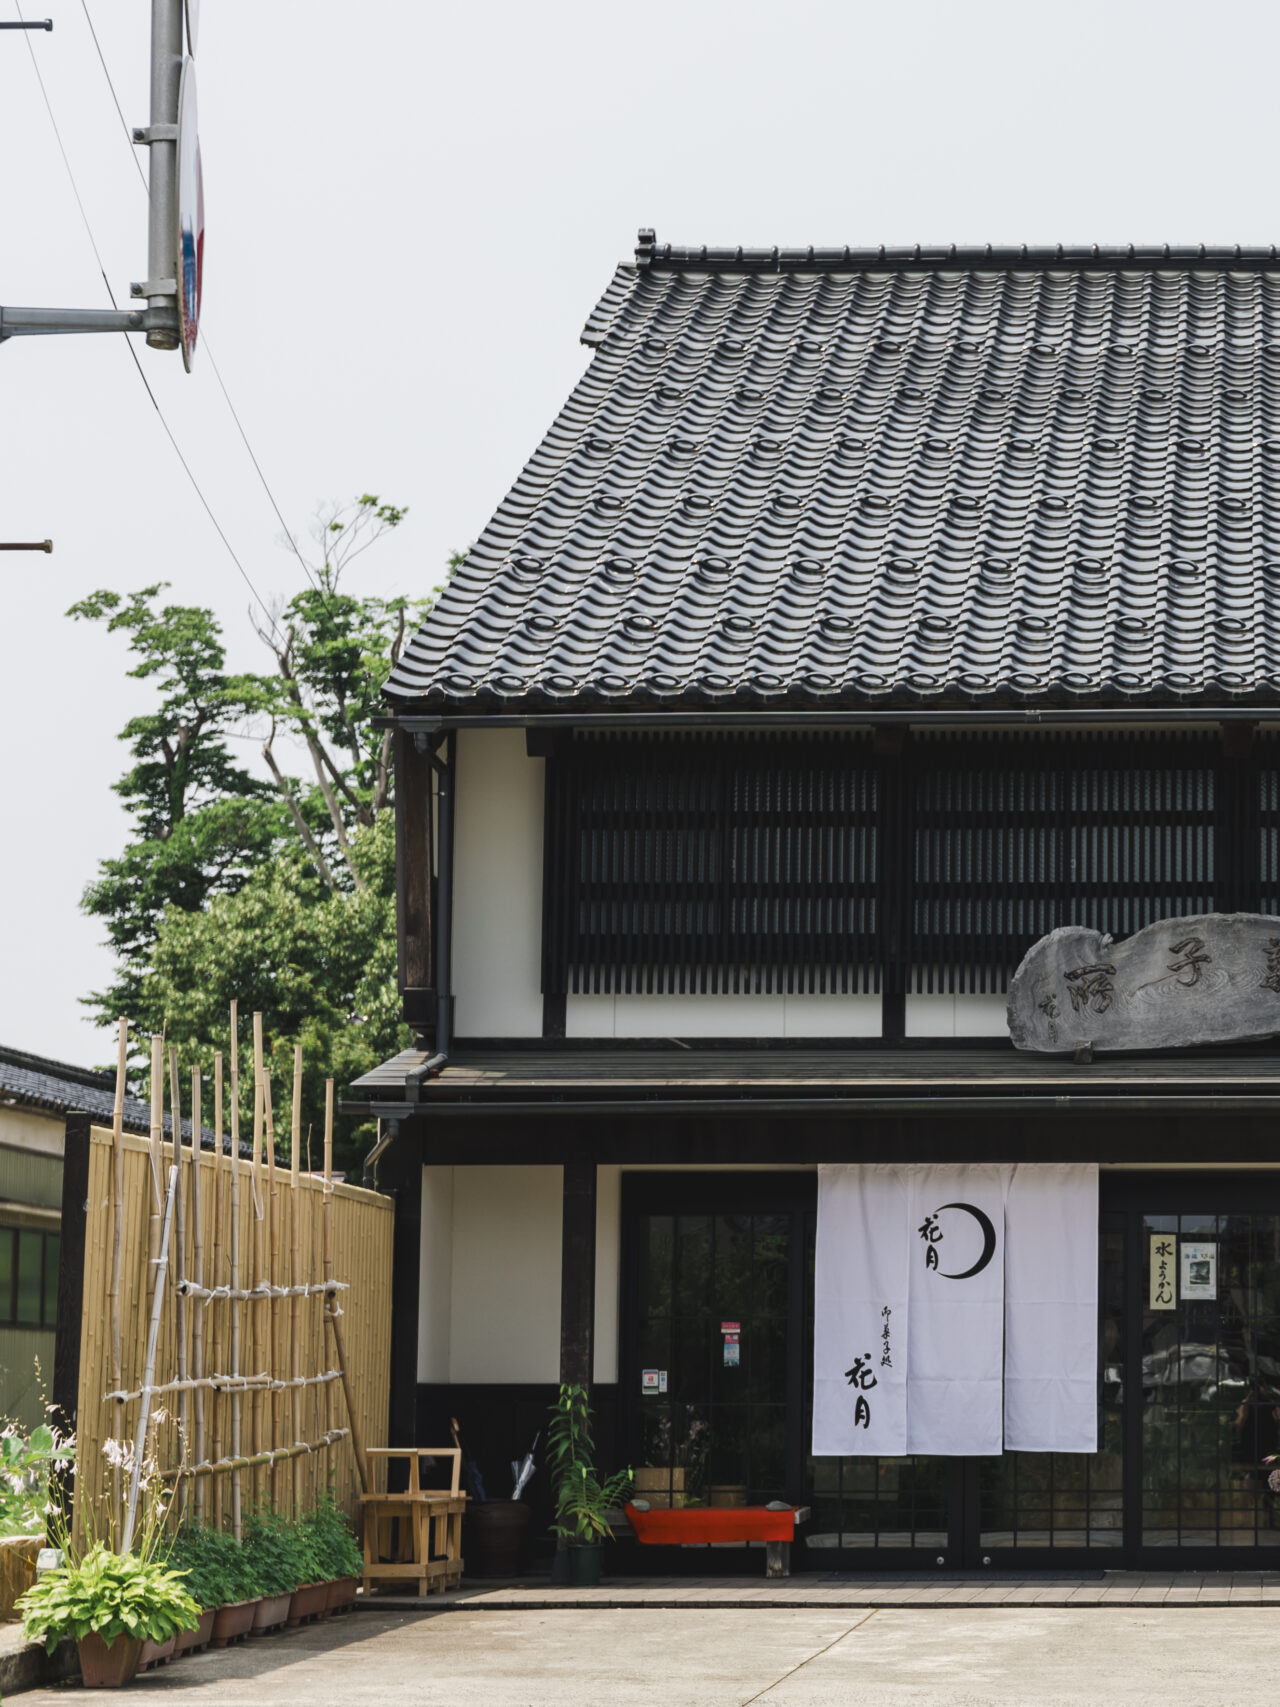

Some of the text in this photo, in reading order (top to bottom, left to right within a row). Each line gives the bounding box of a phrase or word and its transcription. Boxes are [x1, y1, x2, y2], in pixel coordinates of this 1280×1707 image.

[918, 1213, 944, 1271] 花月
[1155, 1241, 1174, 1304] 水ようかん
[880, 1306, 893, 1368] 御菓子処
[844, 1352, 878, 1430] 花月
